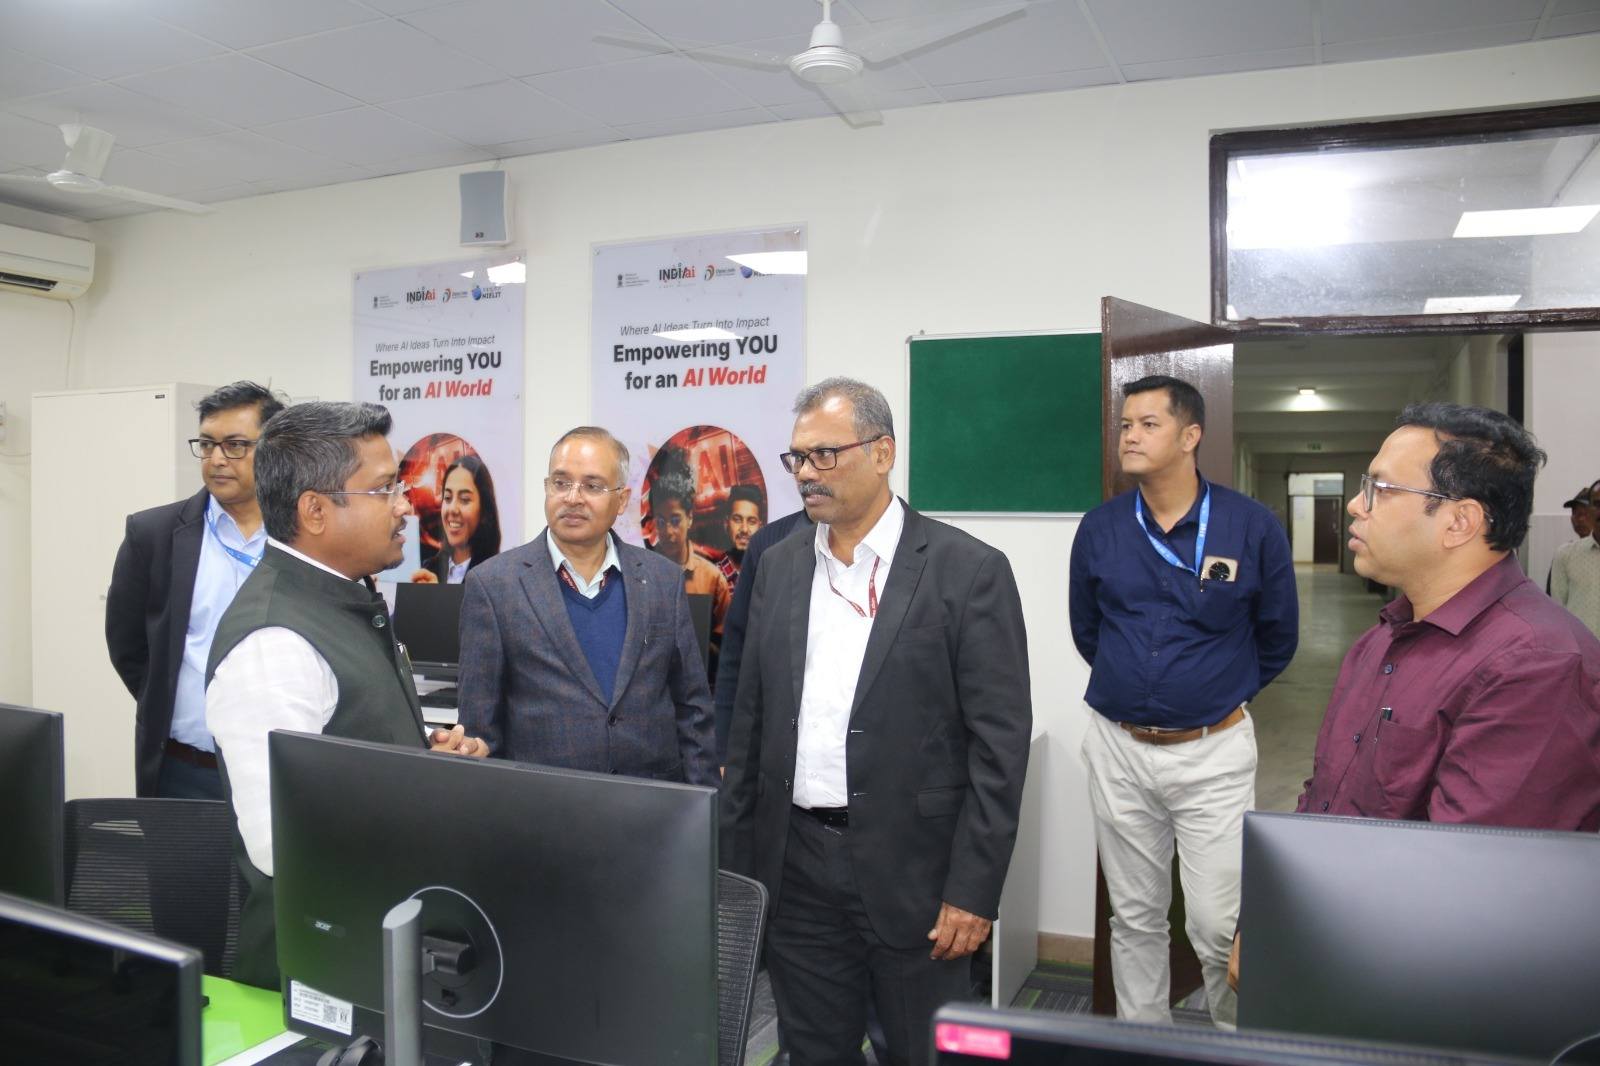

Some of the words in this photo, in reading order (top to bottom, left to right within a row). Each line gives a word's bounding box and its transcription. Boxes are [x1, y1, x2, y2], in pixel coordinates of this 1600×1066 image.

[620, 325, 650, 336] Where
[664, 322, 689, 333] Ideas
[715, 318, 734, 329] Into
[736, 317, 770, 328] Impact
[375, 342, 399, 352] Where
[400, 341, 409, 350] AI
[410, 340, 430, 350] Ideas
[433, 338, 449, 348] Turn
[451, 337, 466, 346] Into
[467, 335, 495, 345] Impact
[613, 340, 730, 365] Empowering
[736, 335, 778, 355] YOU
[370, 355, 463, 379] Empowering
[467, 352, 502, 369] YOU
[625, 371, 651, 390] for
[655, 374, 677, 388] an
[682, 368, 704, 387] AI
[708, 365, 767, 385] World
[379, 384, 400, 401] for
[403, 386, 421, 400] an
[424, 382, 442, 398] AI
[445, 379, 493, 397] World
